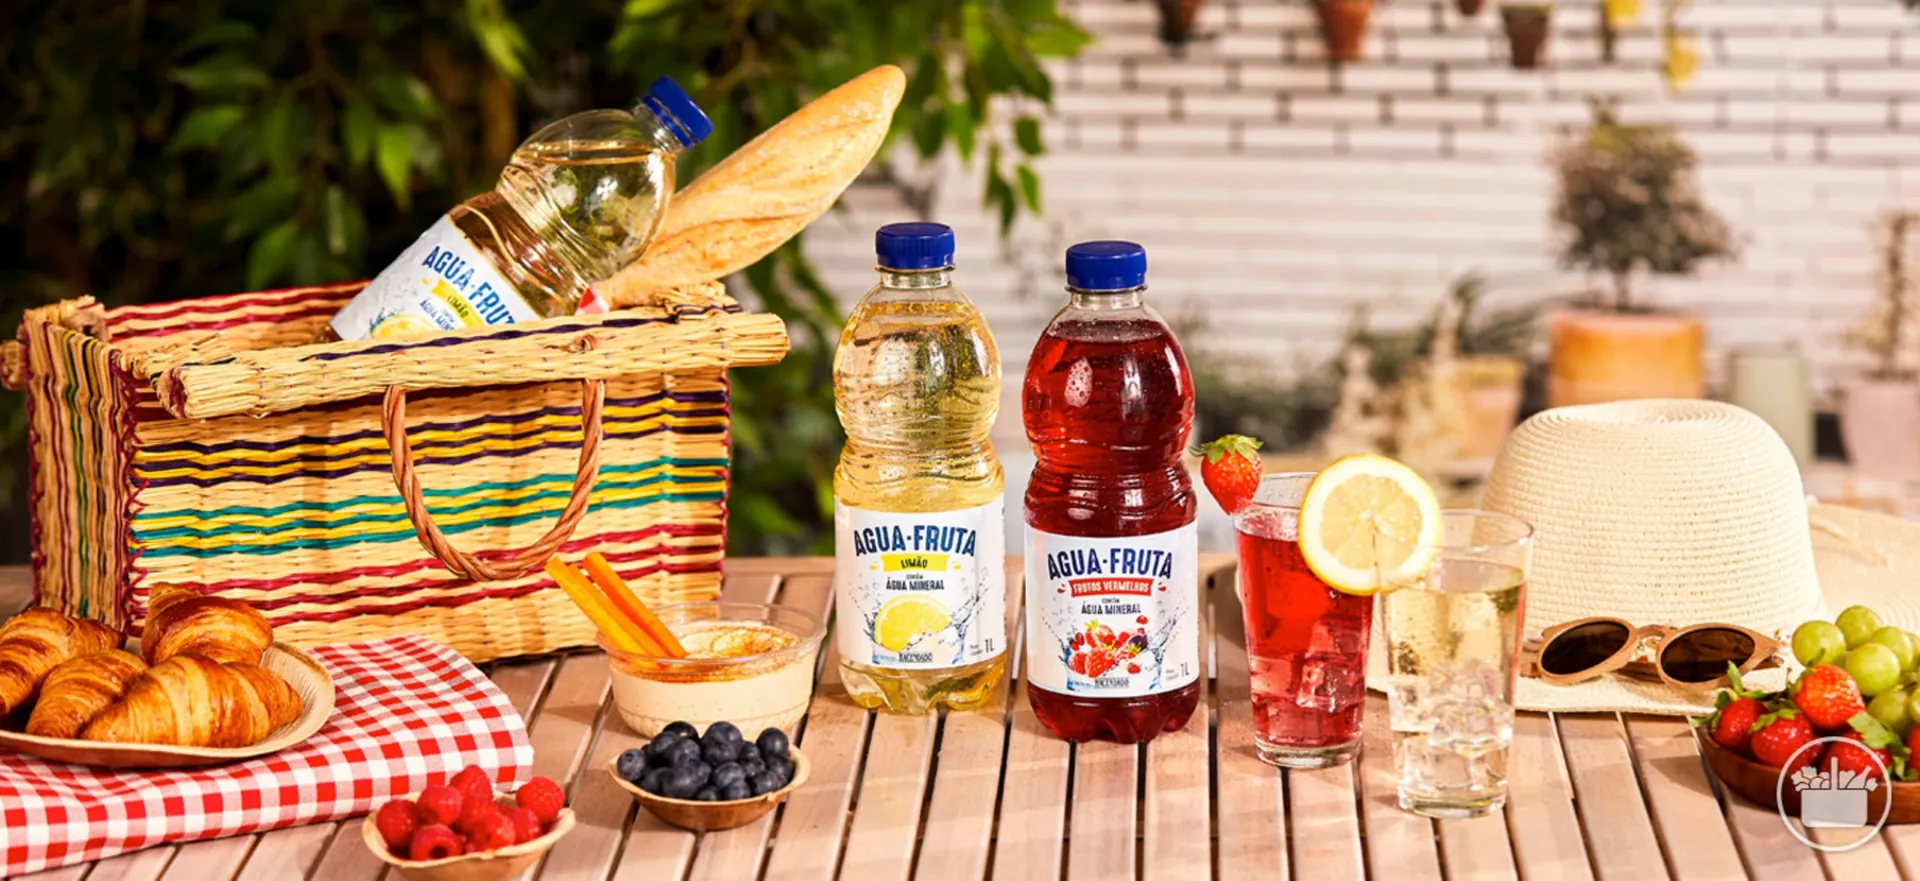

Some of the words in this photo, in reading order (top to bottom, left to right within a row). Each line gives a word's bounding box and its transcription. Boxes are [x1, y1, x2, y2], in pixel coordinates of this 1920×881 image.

[900, 556, 928, 569] LIMÃO
[909, 579, 945, 591] MINERAL
[1072, 581, 1102, 594] FRUTOS
[1103, 580, 1150, 593] VERMELHOS
[1081, 601, 1103, 615] ÁGUA
[1104, 603, 1142, 615] MINERAL
